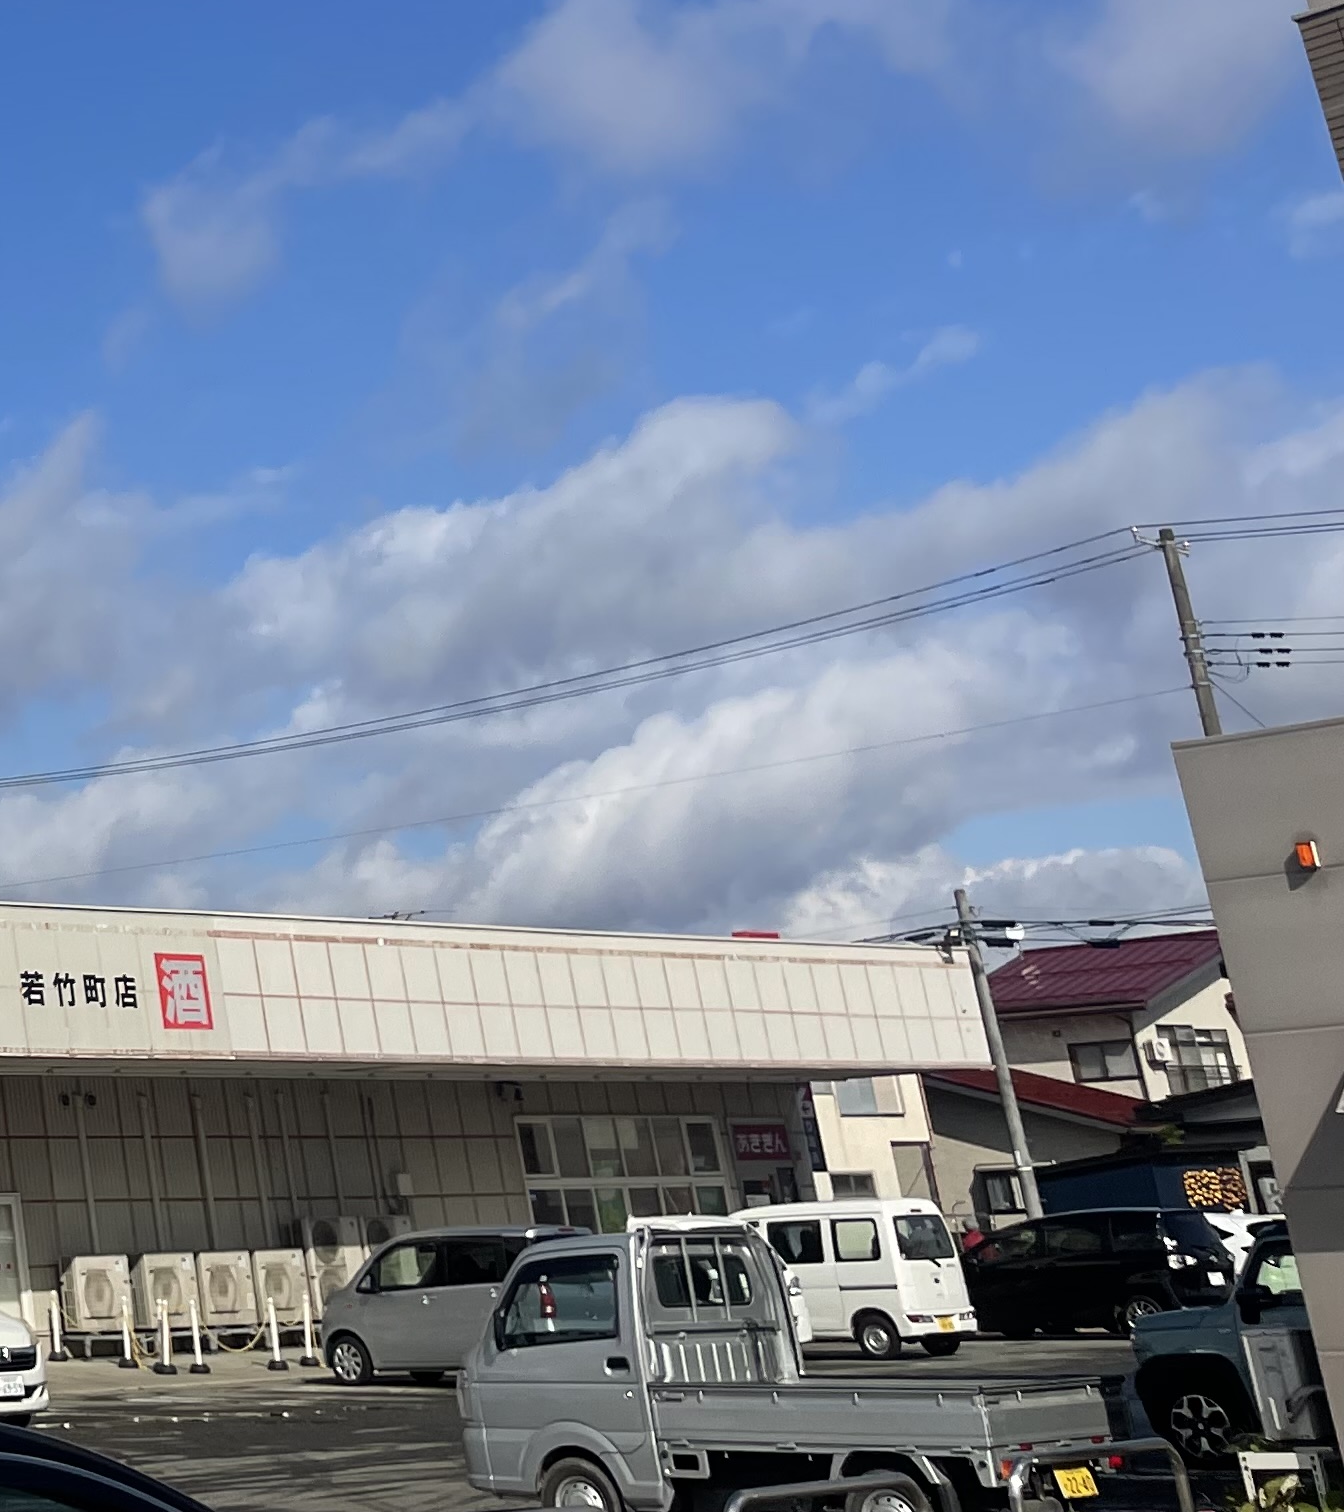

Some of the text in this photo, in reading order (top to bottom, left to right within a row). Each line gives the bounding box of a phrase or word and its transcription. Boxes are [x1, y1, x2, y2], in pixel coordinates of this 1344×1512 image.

[19, 970, 139, 1009] 若竹町店
[159, 957, 210, 1026] 酒
